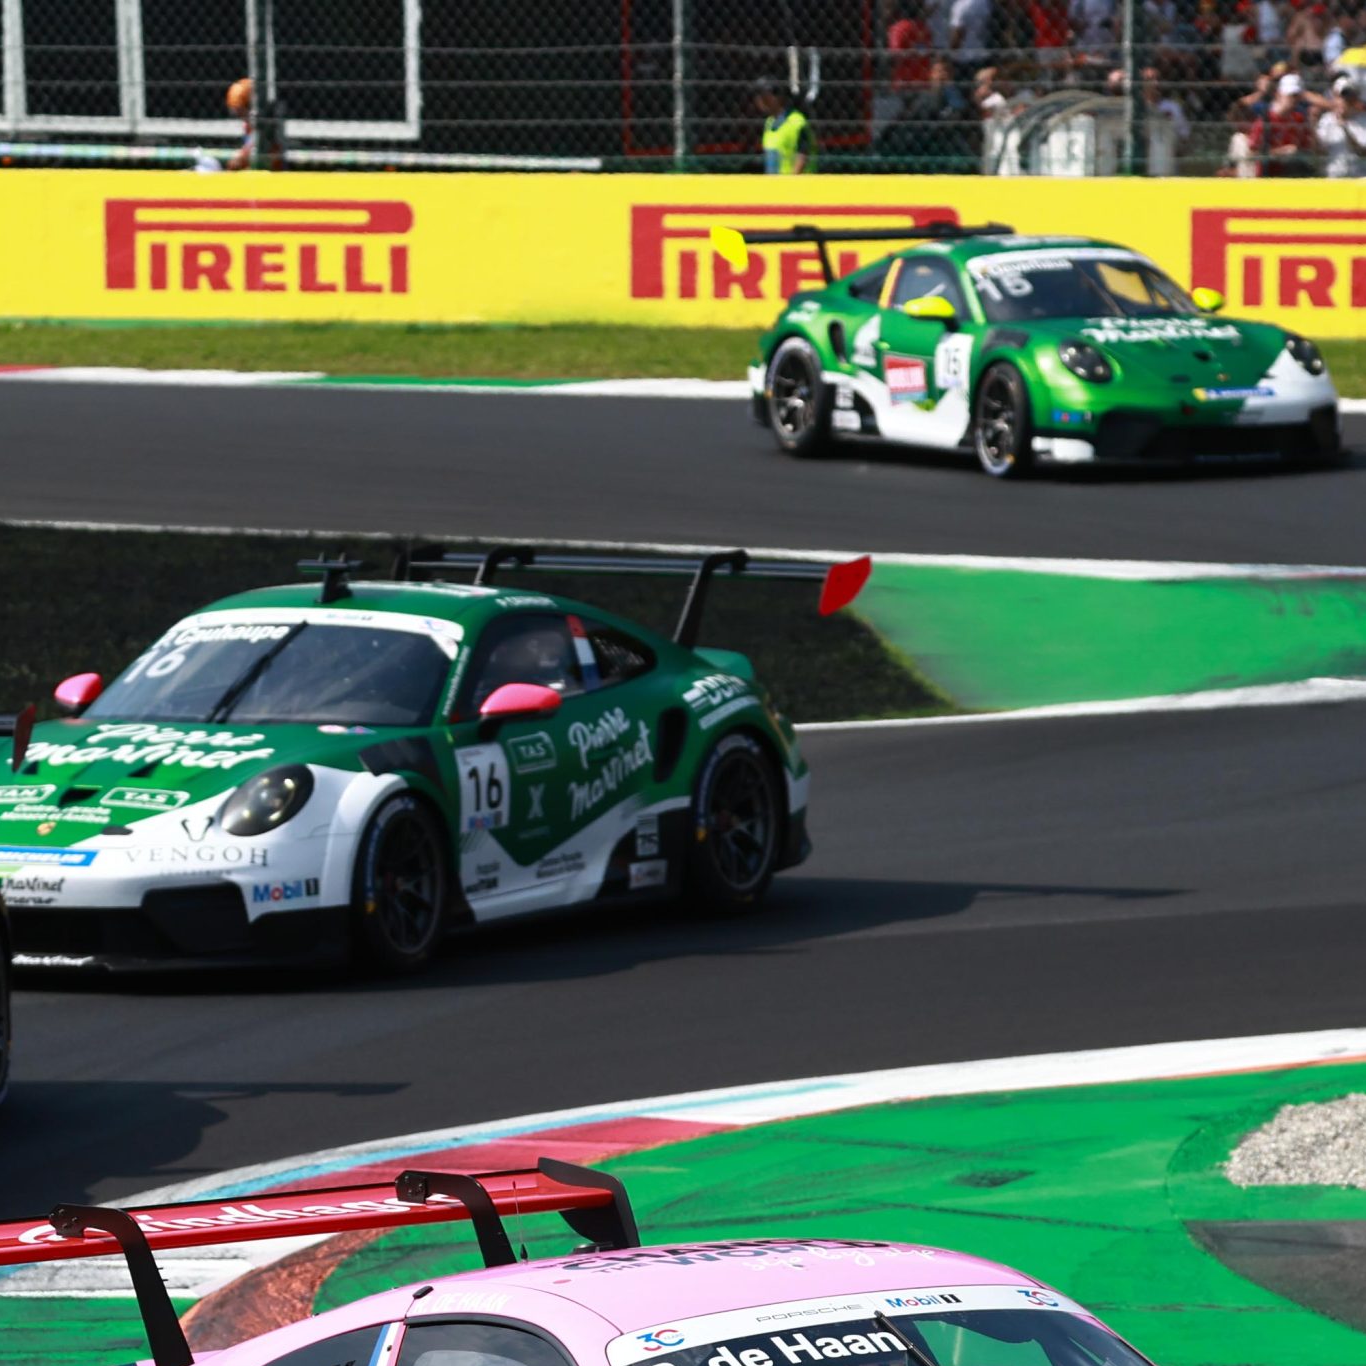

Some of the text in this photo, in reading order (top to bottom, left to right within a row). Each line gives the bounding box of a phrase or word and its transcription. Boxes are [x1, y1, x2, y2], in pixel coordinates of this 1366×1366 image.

[104, 198, 414, 294] PIRELLI
[631, 204, 960, 299] PIRE
[122, 648, 188, 686] 16
[568, 706, 631, 770] Pierre
[467, 762, 503, 812] 16
[124, 846, 270, 868] VENGOH
[252, 880, 304, 904] Mobil
[755, 1303, 864, 1323] PORSCHE
[885, 1295, 939, 1309] Mobil
[772, 1328, 908, 1364] Haan
